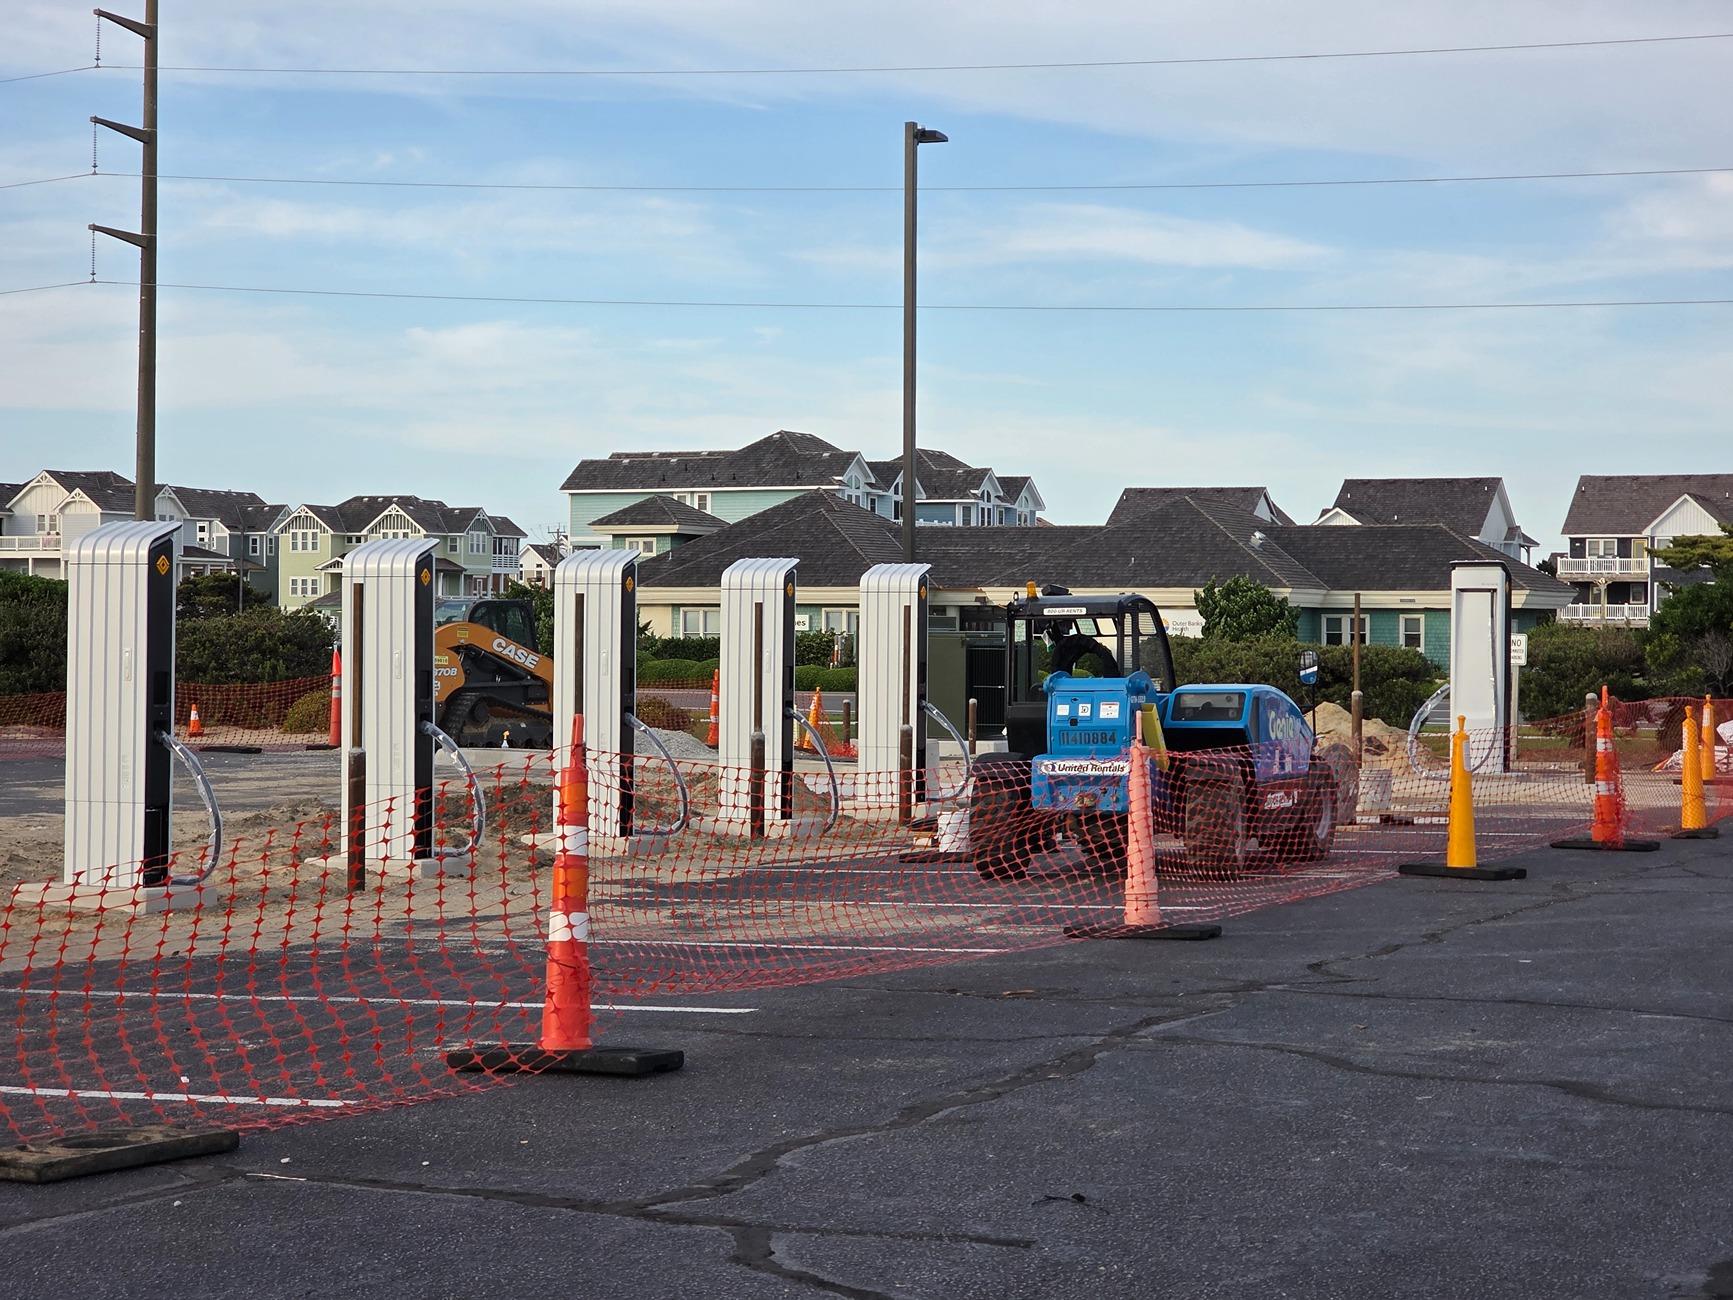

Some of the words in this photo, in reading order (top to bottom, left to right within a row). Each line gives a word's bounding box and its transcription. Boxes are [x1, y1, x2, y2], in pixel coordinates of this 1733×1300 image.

[1511, 639, 1522, 647] NO
[492, 638, 539, 669] CASE
[1269, 710, 1296, 740] Genie
[1061, 732, 1117, 744] 11410884
[1058, 763, 1088, 773] United
[1091, 762, 1125, 773] Rentals
